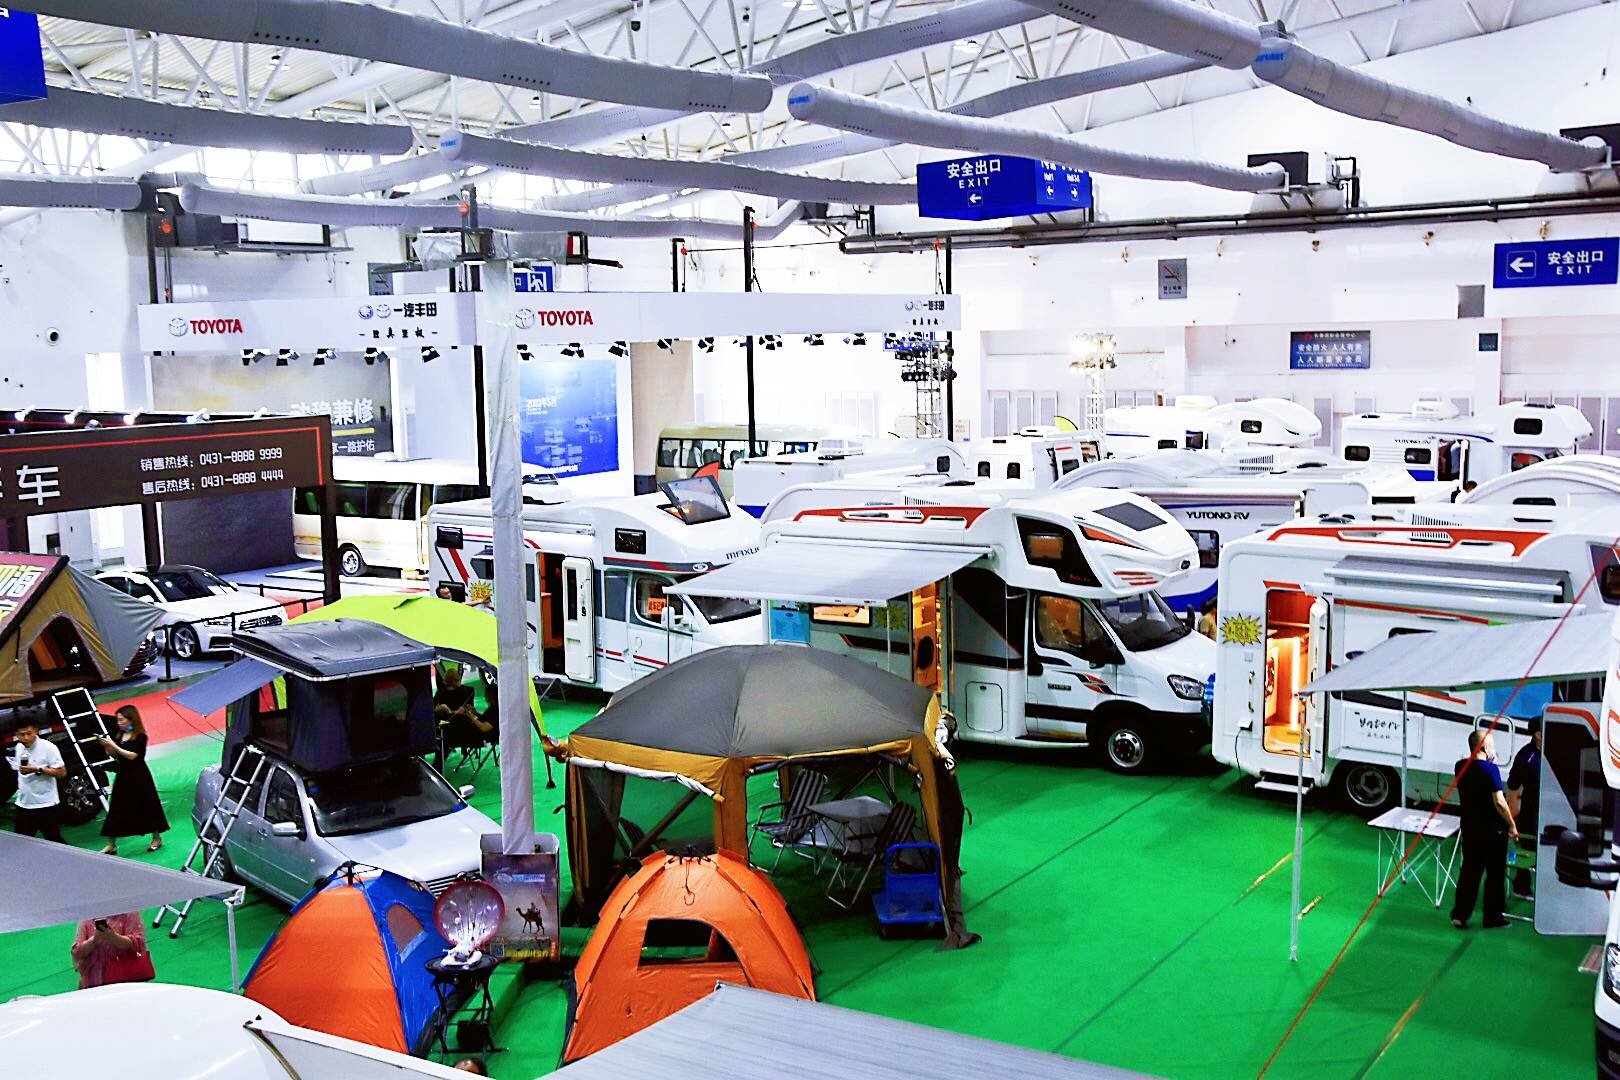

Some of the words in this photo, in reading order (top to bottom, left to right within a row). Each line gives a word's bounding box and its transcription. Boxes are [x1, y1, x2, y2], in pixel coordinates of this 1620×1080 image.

[947, 159, 1001, 179] 安全出口
[959, 177, 990, 189] EXIT
[1547, 250, 1603, 265] 安全出口
[1556, 265, 1592, 275] EXIT
[393, 302, 437, 317] 一汽丰田
[538, 310, 594, 326] TOYOTA
[190, 319, 243, 334] TOYOTA
[200, 450, 255, 465] 0431-8888
[259, 447, 283, 460] 9999
[0, 465, 61, 506] 车
[201, 472, 257, 488] 0431-8888
[261, 469, 284, 481] 4444
[1186, 511, 1232, 520] YUTONG
[1233, 511, 1250, 520] RV
